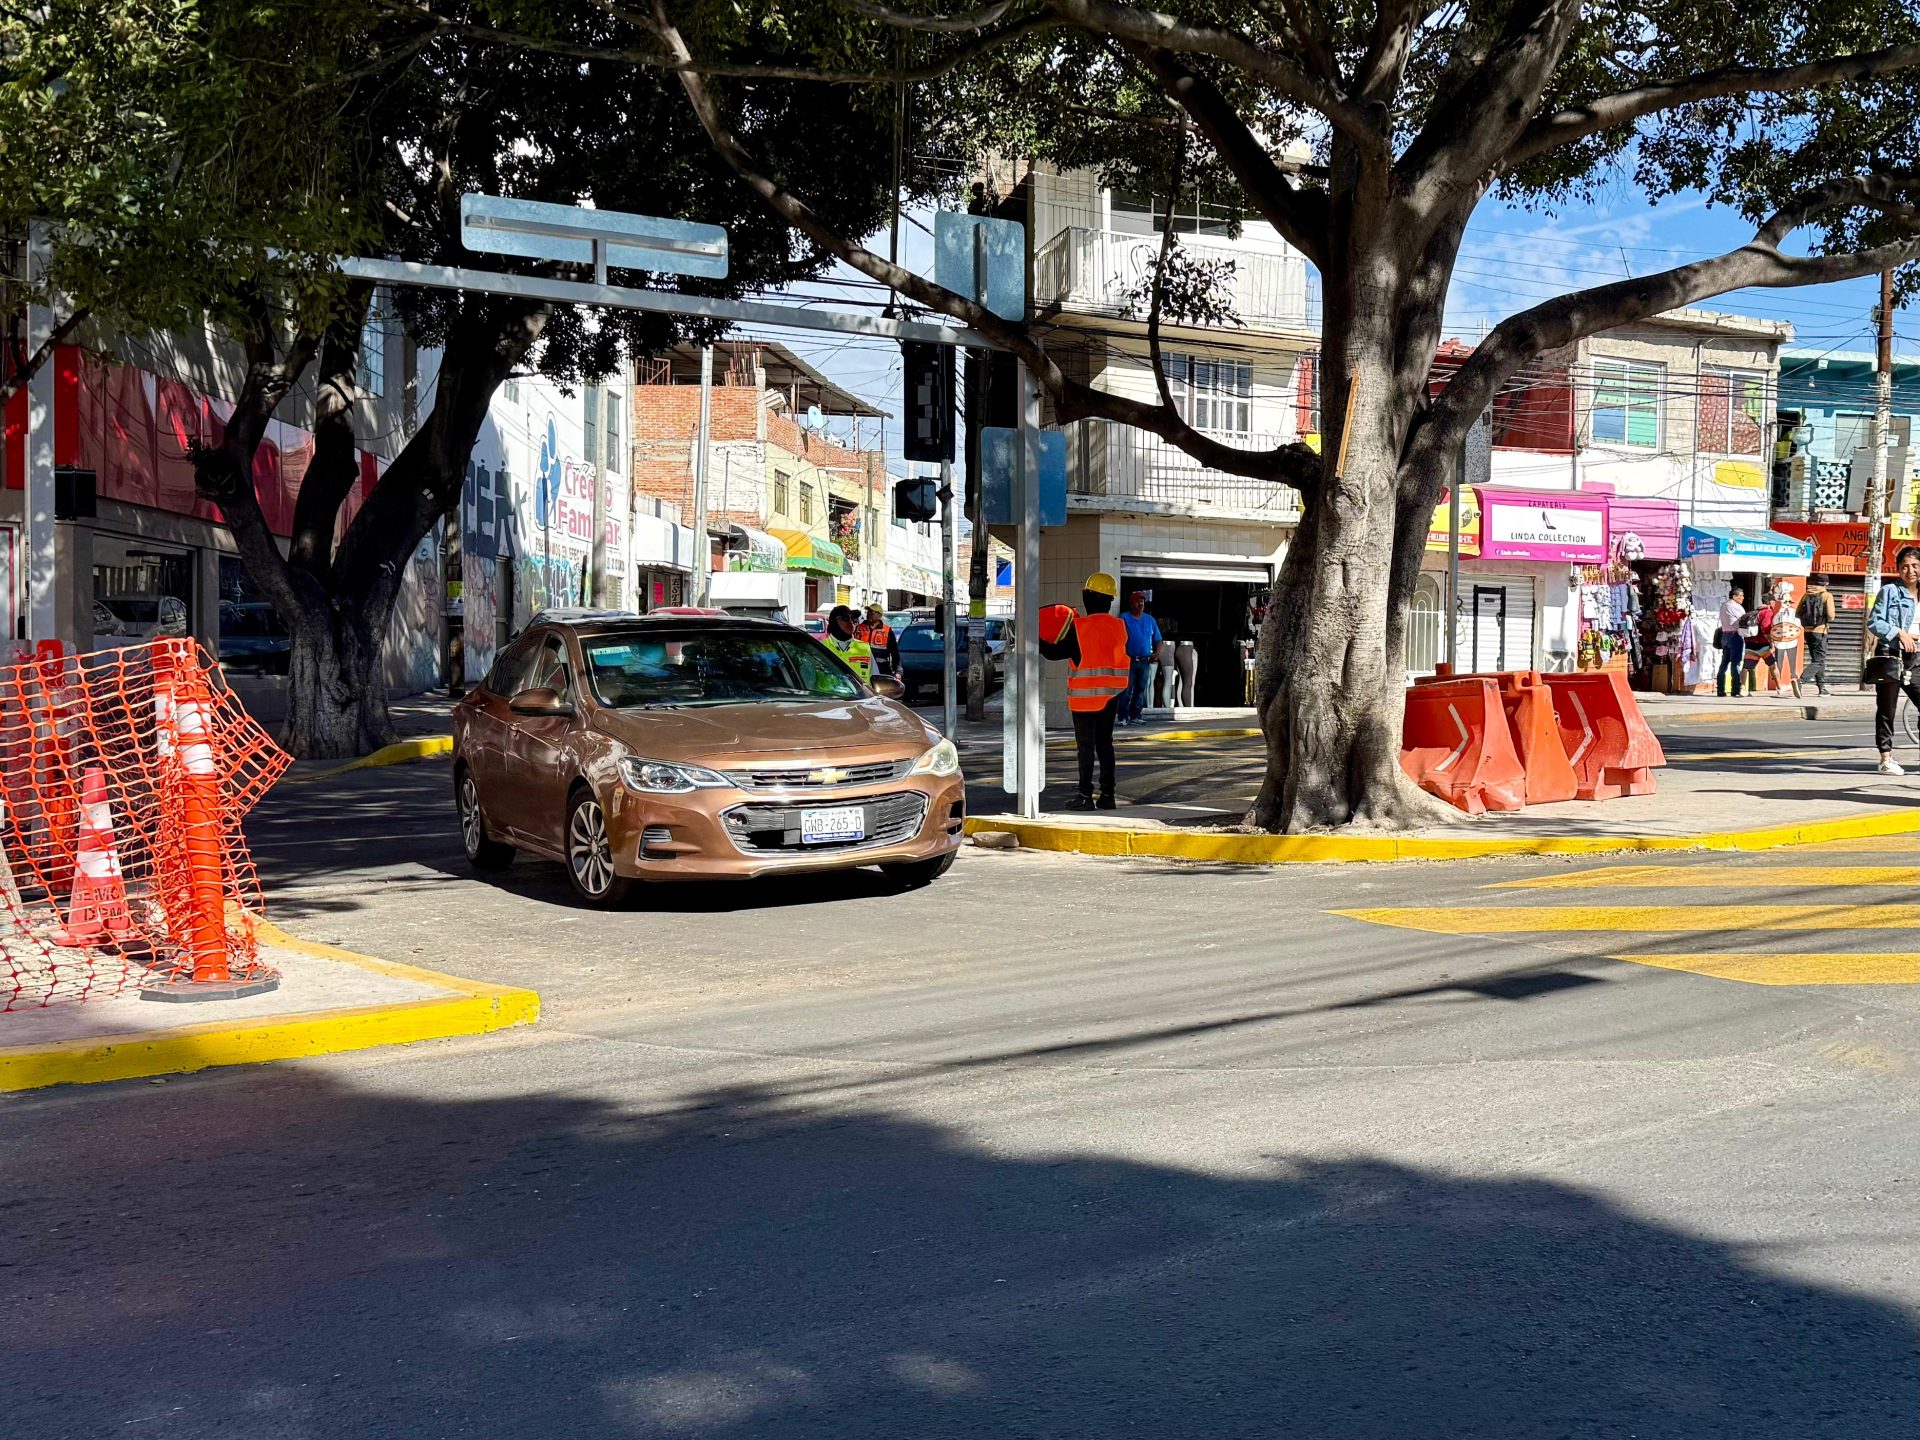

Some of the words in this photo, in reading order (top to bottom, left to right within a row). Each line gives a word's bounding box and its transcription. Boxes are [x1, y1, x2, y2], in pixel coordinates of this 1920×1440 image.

[557, 499, 622, 546] Famar
[1510, 532, 1535, 541] LINDA
[1538, 533, 1586, 543] COLLECTION
[804, 816, 862, 833] GWB-265-D
